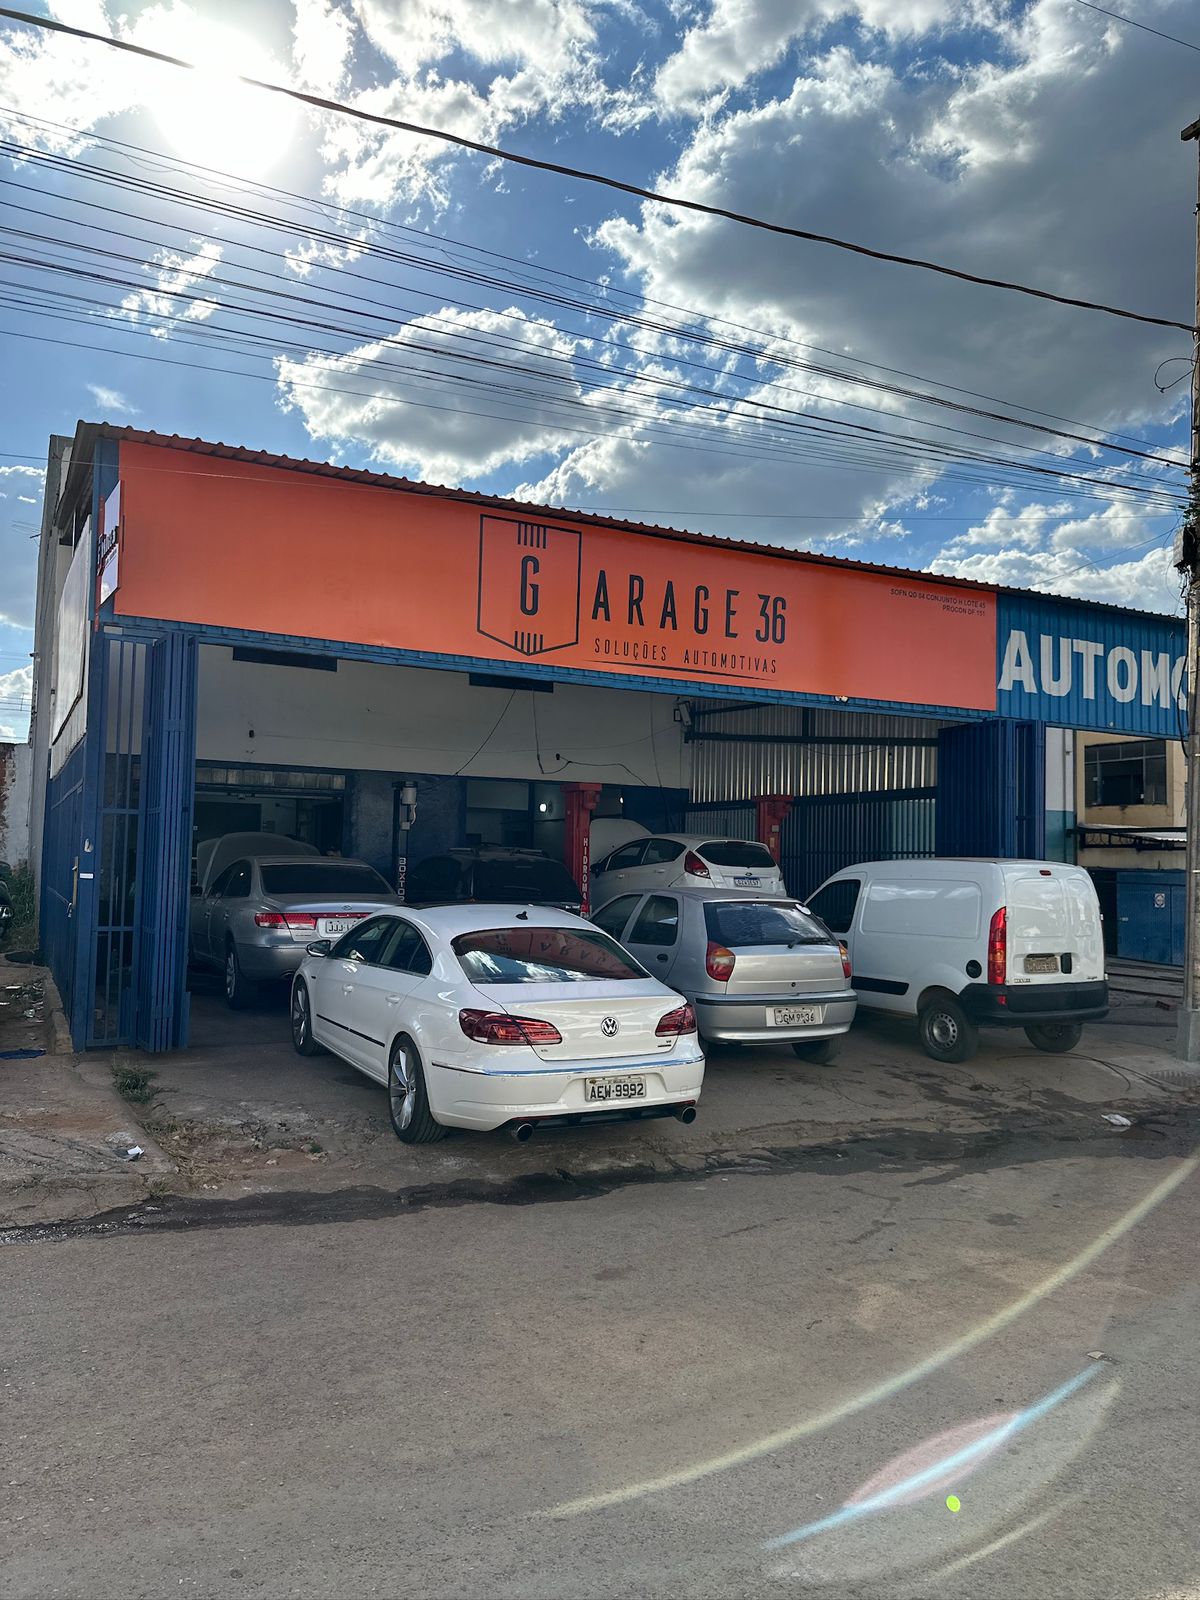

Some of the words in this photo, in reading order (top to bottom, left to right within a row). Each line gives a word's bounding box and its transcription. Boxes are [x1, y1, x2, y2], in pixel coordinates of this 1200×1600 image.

[926, 594, 958, 604] CONJUNTO
[963, 599, 978, 608] LOTE
[942, 604, 967, 614] PROCON
[755, 593, 787, 645] 36
[594, 638, 667, 662] SOLUÇÕES
[684, 650, 778, 674] AUTOMOTIVAS
